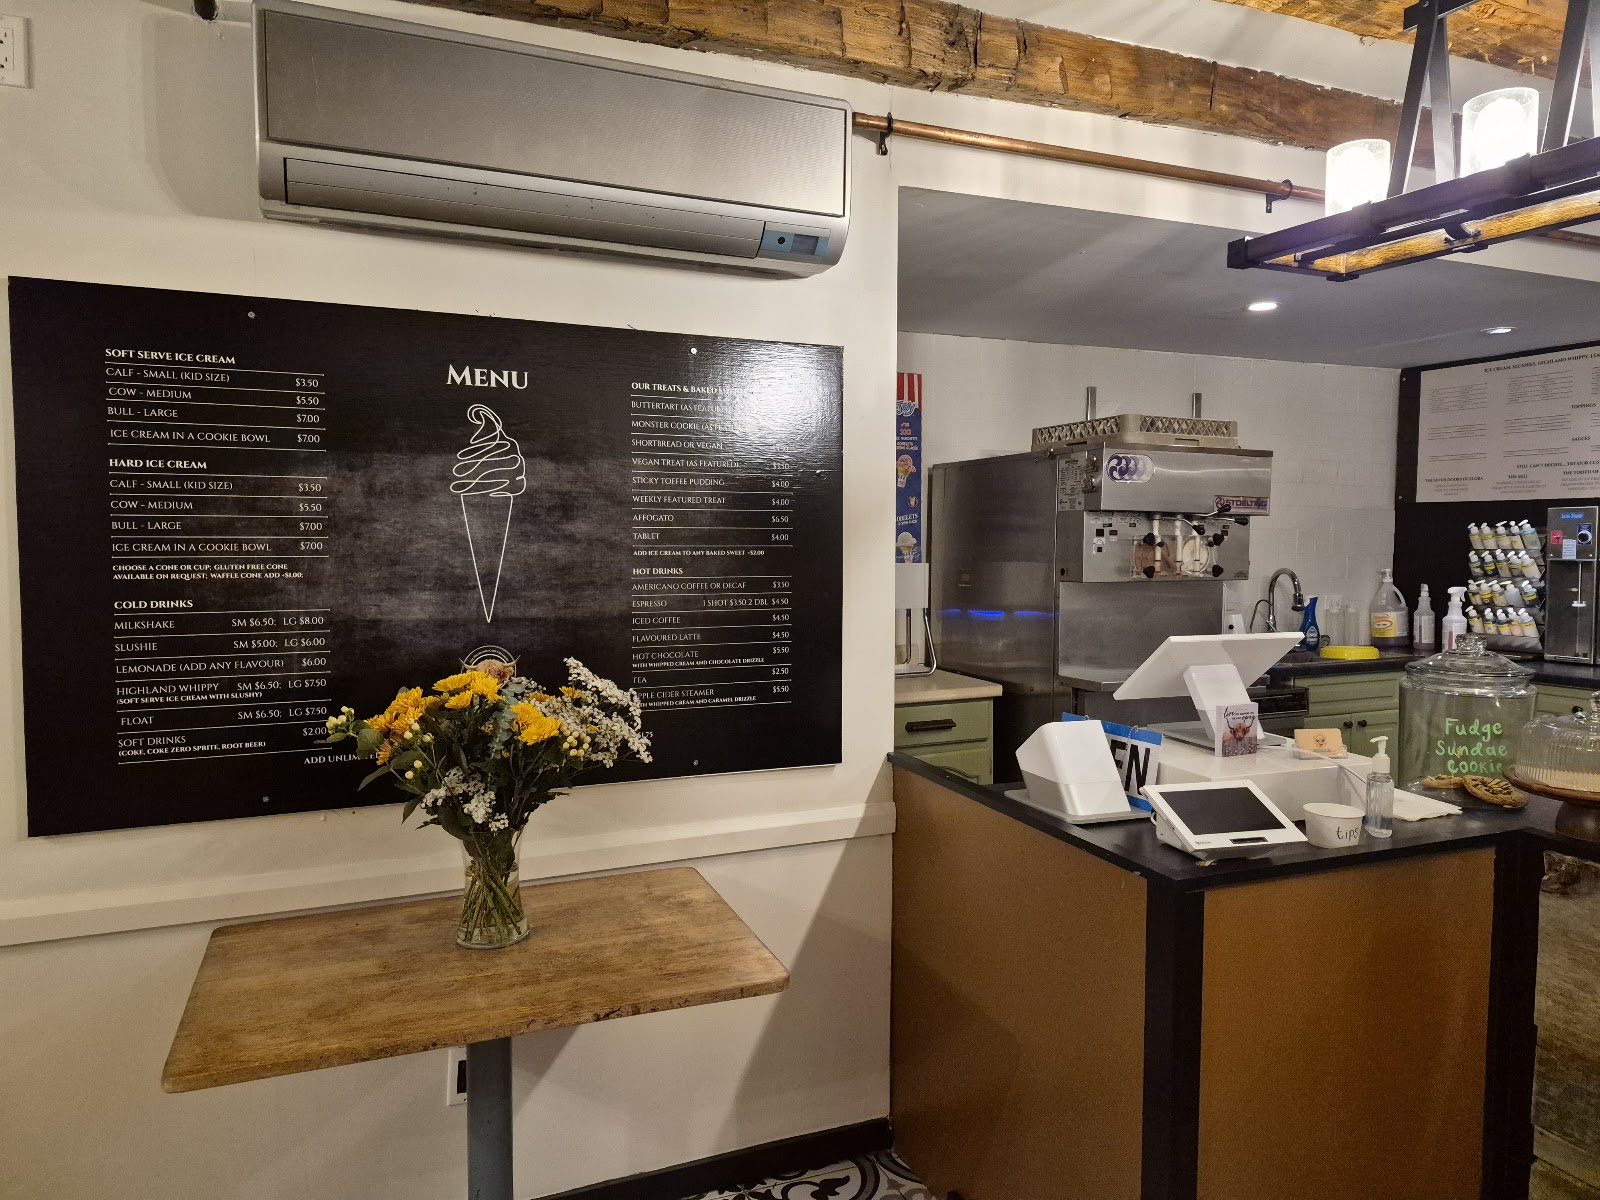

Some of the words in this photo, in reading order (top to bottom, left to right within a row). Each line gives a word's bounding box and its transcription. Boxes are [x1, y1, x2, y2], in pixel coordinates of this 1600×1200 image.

[106, 349, 135, 357] SOFT
[138, 351, 172, 360] SERVE
[175, 353, 193, 361] ICE
[196, 355, 235, 364] CREAM
[106, 368, 133, 376] CALF
[144, 370, 177, 379] SMALL
[181, 372, 202, 380] (KID
[206, 373, 229, 382] SIZE)
[296, 378, 318, 387] $3.50
[147, 390, 191, 398] MEDIUM
[691, 385, 718, 395] BAKED
[296, 396, 319, 405] $5.50
[632, 401, 679, 410] BUTTERTART
[108, 407, 134, 415] BULL
[144, 409, 177, 417] LARGE
[297, 414, 319, 422] $7.00
[671, 422, 700, 430] COOKIE
[131, 430, 169, 439] CREAM
[198, 433, 237, 441] COOKIE
[242, 434, 270, 442] BOWL
[298, 434, 320, 442] $7.00
[632, 439, 682, 447] SHORTBREAD
[696, 441, 724, 450] VEGAN
[110, 459, 143, 467] HARD
[167, 461, 207, 469] CREAM
[110, 480, 136, 488] CALF
[184, 481, 206, 489] (KID
[209, 482, 232, 490] SIZE)
[299, 483, 321, 492] $3.50
[299, 503, 321, 511] $5.50
[300, 522, 322, 530] $7.00
[300, 542, 322, 550] $7.00
[114, 601, 147, 609] COLD
[151, 600, 193, 608] DRINKS
[115, 621, 174, 629] MILKSHAKE
[284, 617, 296, 625] LG
[300, 617, 323, 625] $8.00
[301, 638, 325, 646] $6.00
[633, 634, 677, 642] FLAVOURED
[115, 643, 157, 651] SLUSHIE
[651, 651, 698, 659] CHOCOLATE
[116, 664, 176, 673] LEMONADE
[180, 663, 206, 671] (ADD
[235, 660, 283, 668] FLAVOUR)
[302, 658, 326, 666] $6.00
[289, 680, 301, 688] LG
[305, 679, 326, 687] $7.50
[117, 686, 176, 696] HIGHLAND
[179, 683, 219, 691] WHIPPY
[289, 708, 302, 716] LG
[305, 707, 327, 715] $7.50
[122, 717, 152, 725] FLOAT
[303, 725, 328, 736] $2.00
[1445, 718, 1502, 741] Fudge
[119, 738, 144, 747] SOFT
[148, 736, 185, 745] DRINKS
[1435, 740, 1507, 756] Sundae
[304, 756, 325, 764] ADD
[1336, 827, 1359, 842] tips
